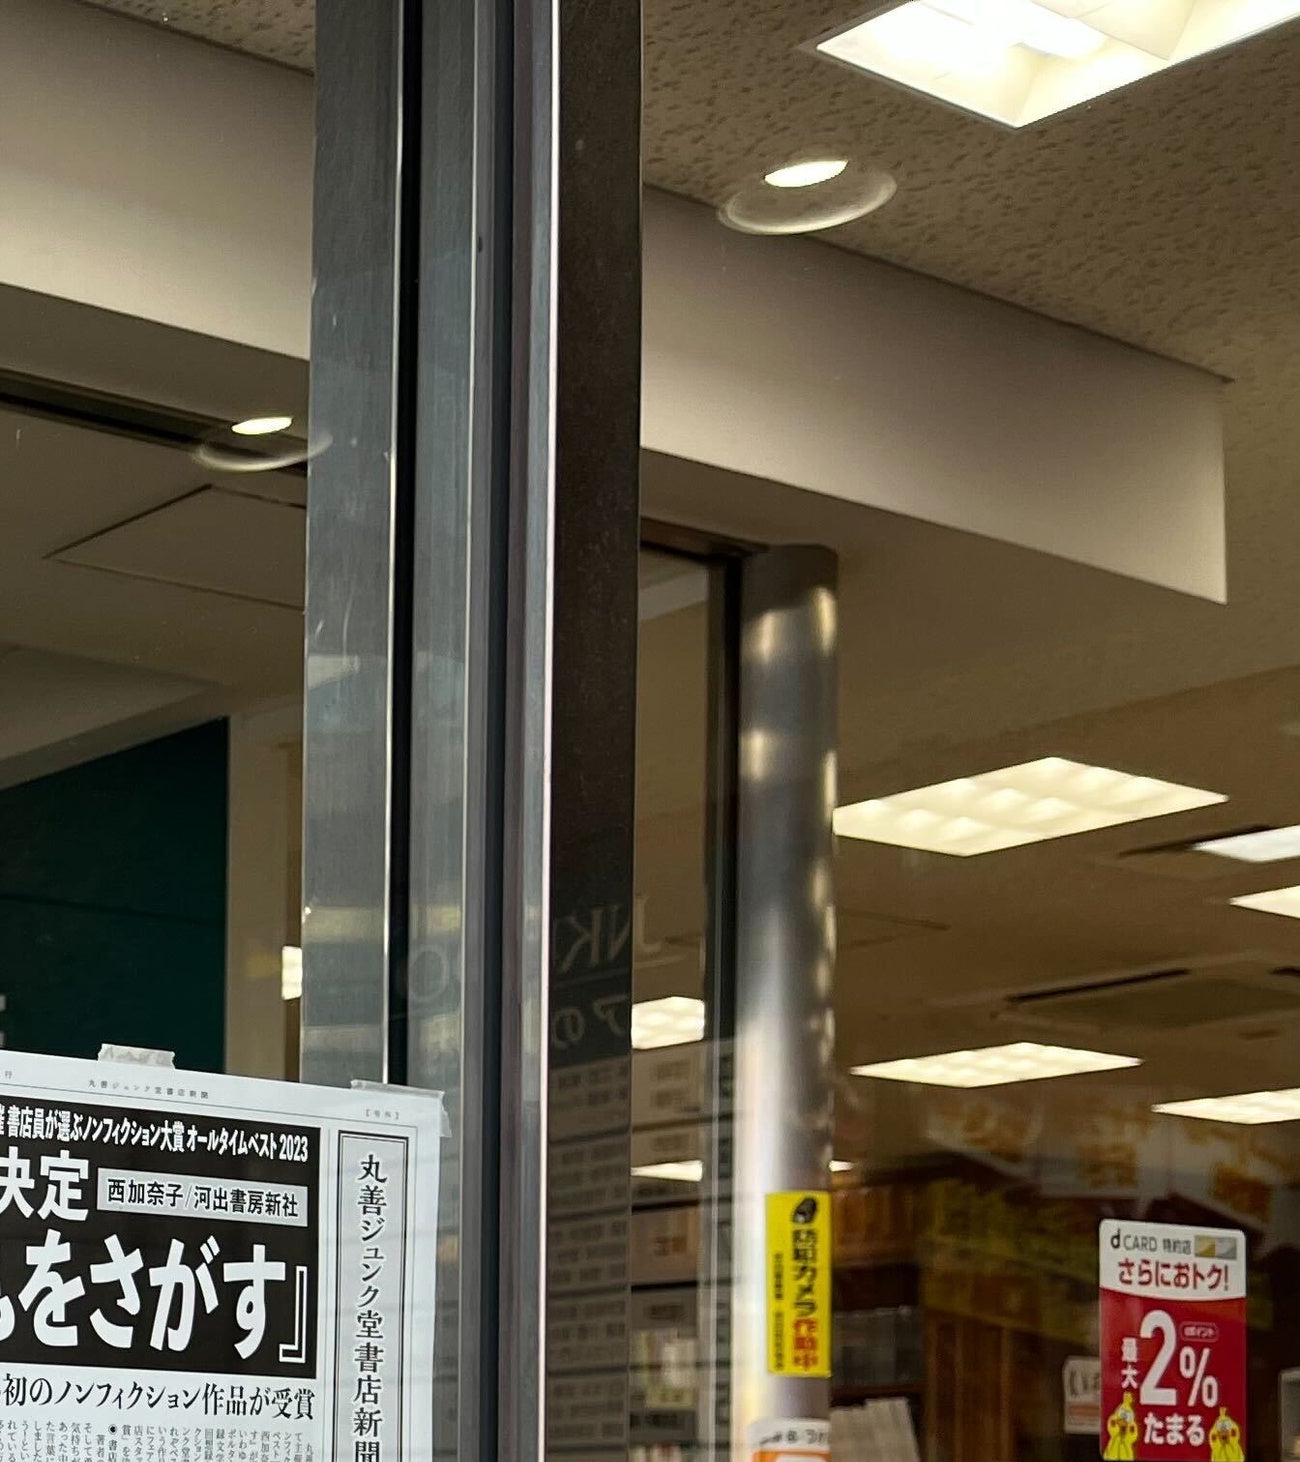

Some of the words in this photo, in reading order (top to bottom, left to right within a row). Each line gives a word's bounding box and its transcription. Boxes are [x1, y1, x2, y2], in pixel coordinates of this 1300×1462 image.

[7, 1103, 185, 1153] 書店員が選ぶノンフィクション大賞
[186, 1126, 278, 1161] オールタイムベスト
[278, 1133, 309, 1163] 2023
[1122, 1234, 1158, 1251] CARD
[1120, 1337, 1139, 1390] 最大
[1138, 1309, 1219, 1408] 2%
[1144, 1412, 1205, 1447] たまる
